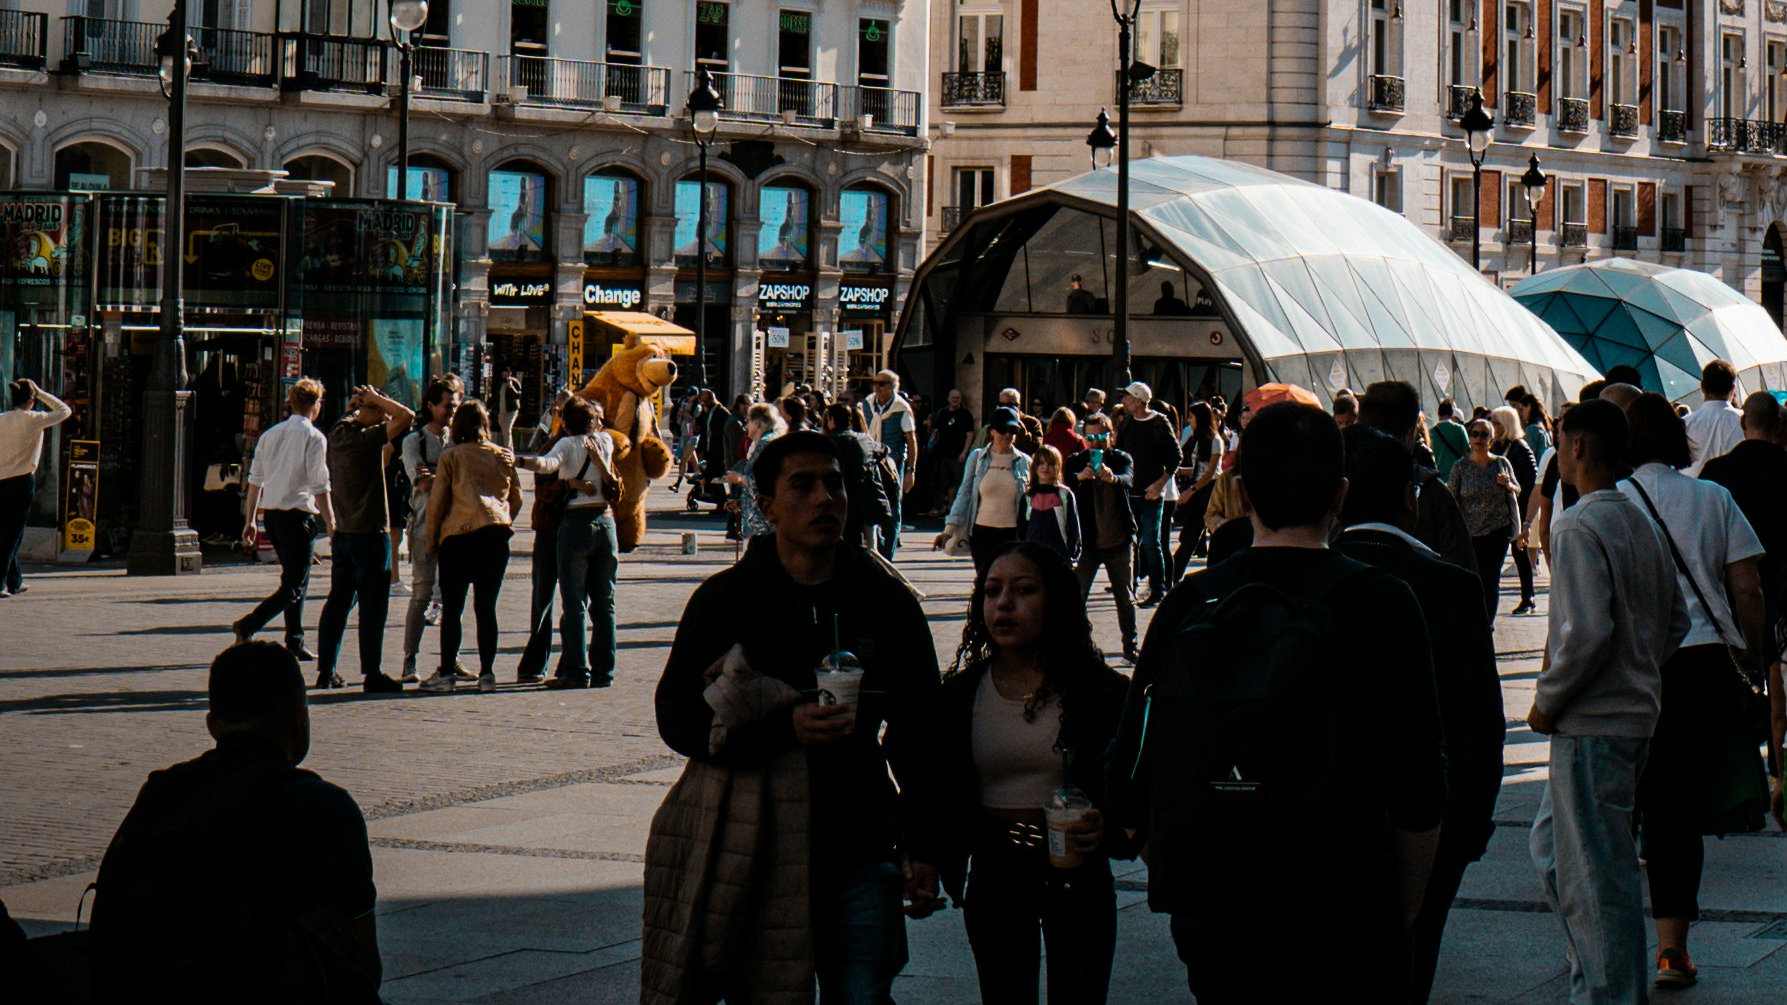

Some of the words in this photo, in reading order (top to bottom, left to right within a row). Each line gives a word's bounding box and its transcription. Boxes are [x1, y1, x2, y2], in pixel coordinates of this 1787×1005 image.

[3, 203, 63, 223] MADRID
[189, 206, 221, 215] DRINKS
[357, 211, 415, 232] MADRID
[108, 228, 141, 247] BIG
[493, 283, 518, 297] WITH
[585, 285, 641, 308] Change
[759, 284, 810, 300] ZAPSHOP
[840, 287, 889, 303] ZAPSHOP
[1091, 328, 1115, 344] SO
[71, 534, 89, 544] 35€
